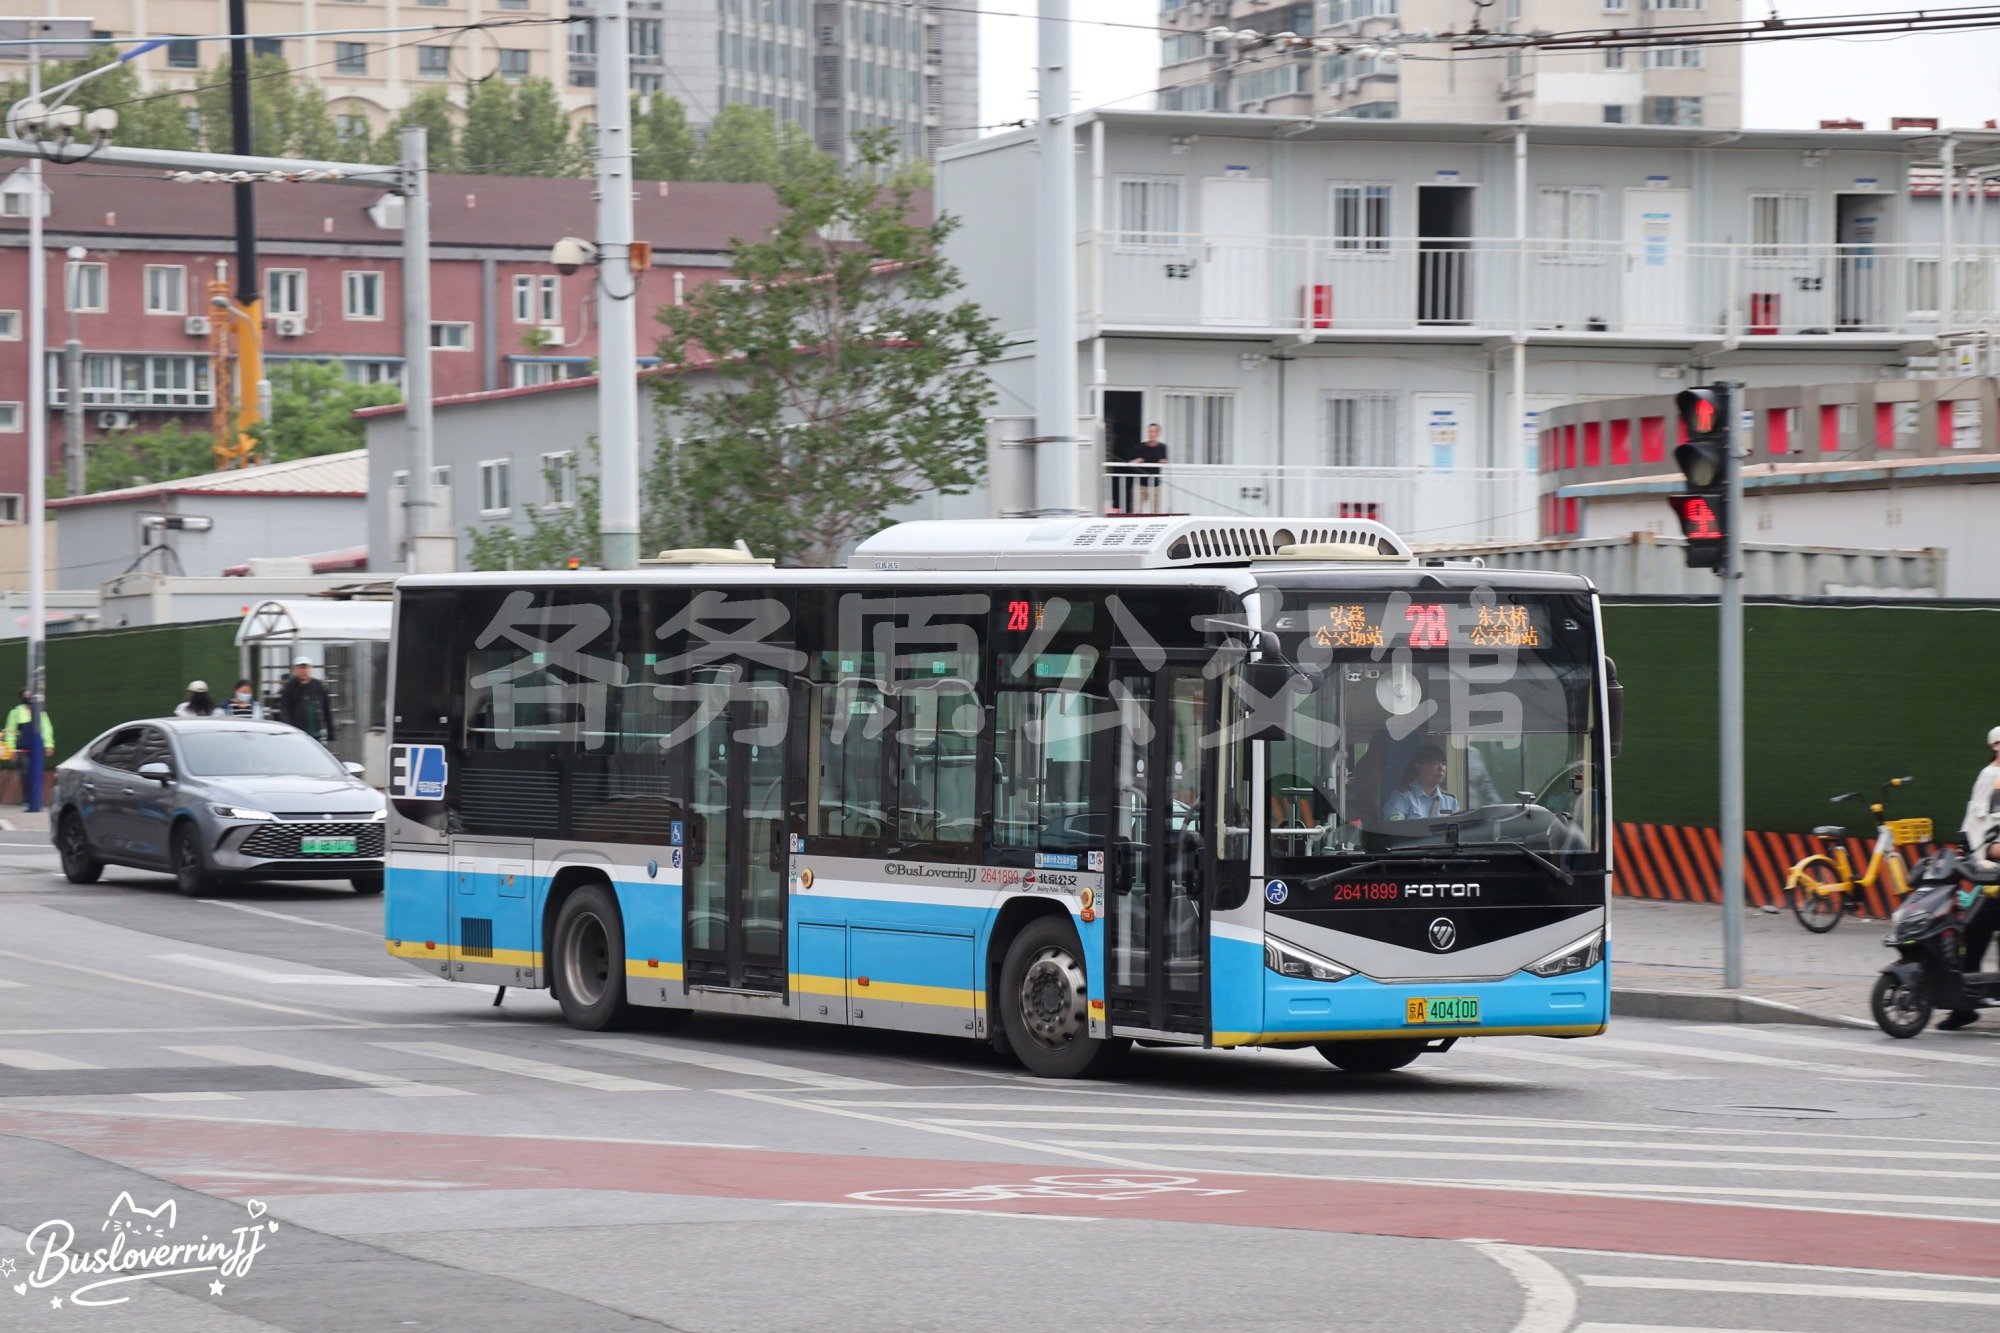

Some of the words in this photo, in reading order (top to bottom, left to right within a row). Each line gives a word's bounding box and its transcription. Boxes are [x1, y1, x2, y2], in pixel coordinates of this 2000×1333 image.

[1007, 601, 1029, 630] 28
[1329, 605, 1366, 628] 弘燕
[1406, 605, 1448, 646] 28
[1477, 605, 1528, 629] 东大桥
[1315, 626, 1384, 646] 公交场站
[1471, 626, 1538, 646] 公交场站
[981, 868, 1019, 884] 2641899
[1038, 873, 1078, 886] 北京公交
[1334, 883, 1398, 900] 2641899
[1404, 883, 1480, 898] FOTON
